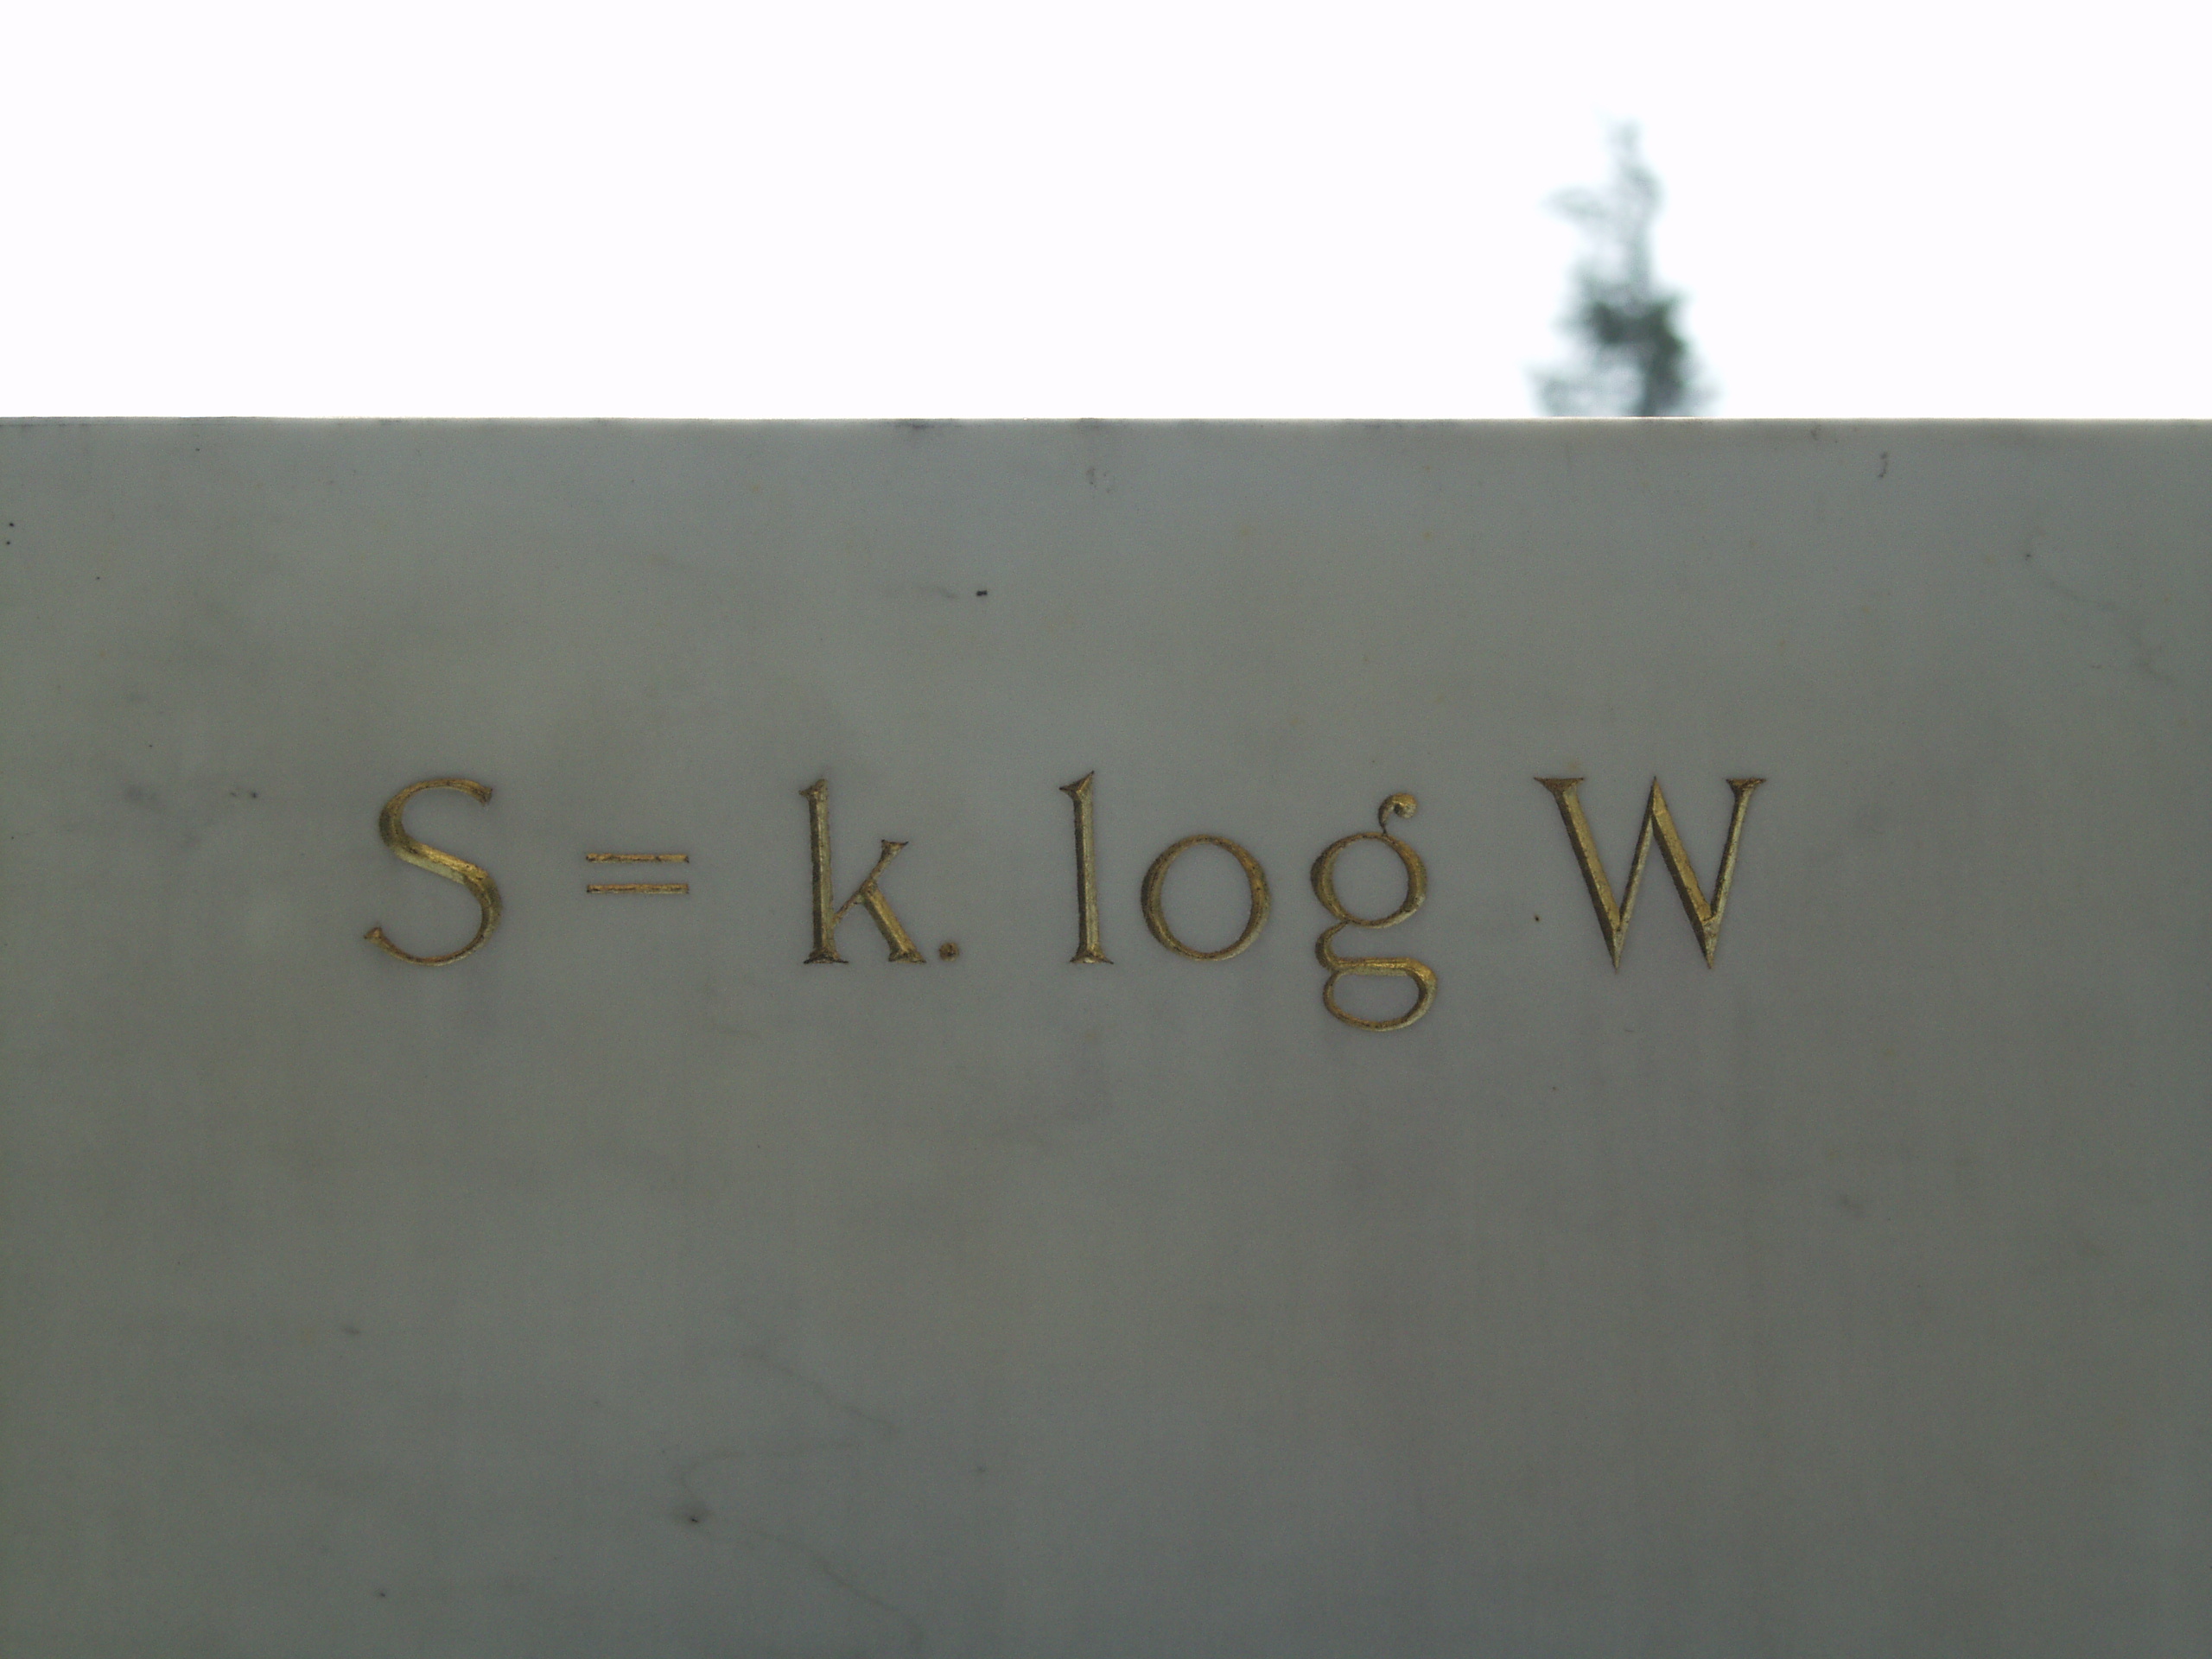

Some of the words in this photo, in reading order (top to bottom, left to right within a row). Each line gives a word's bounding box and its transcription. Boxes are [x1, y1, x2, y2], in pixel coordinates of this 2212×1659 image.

[364, 777, 504, 967] S
[586, 852, 690, 895] =
[1059, 770, 1439, 1033] log
[1534, 776, 1766, 973] W
